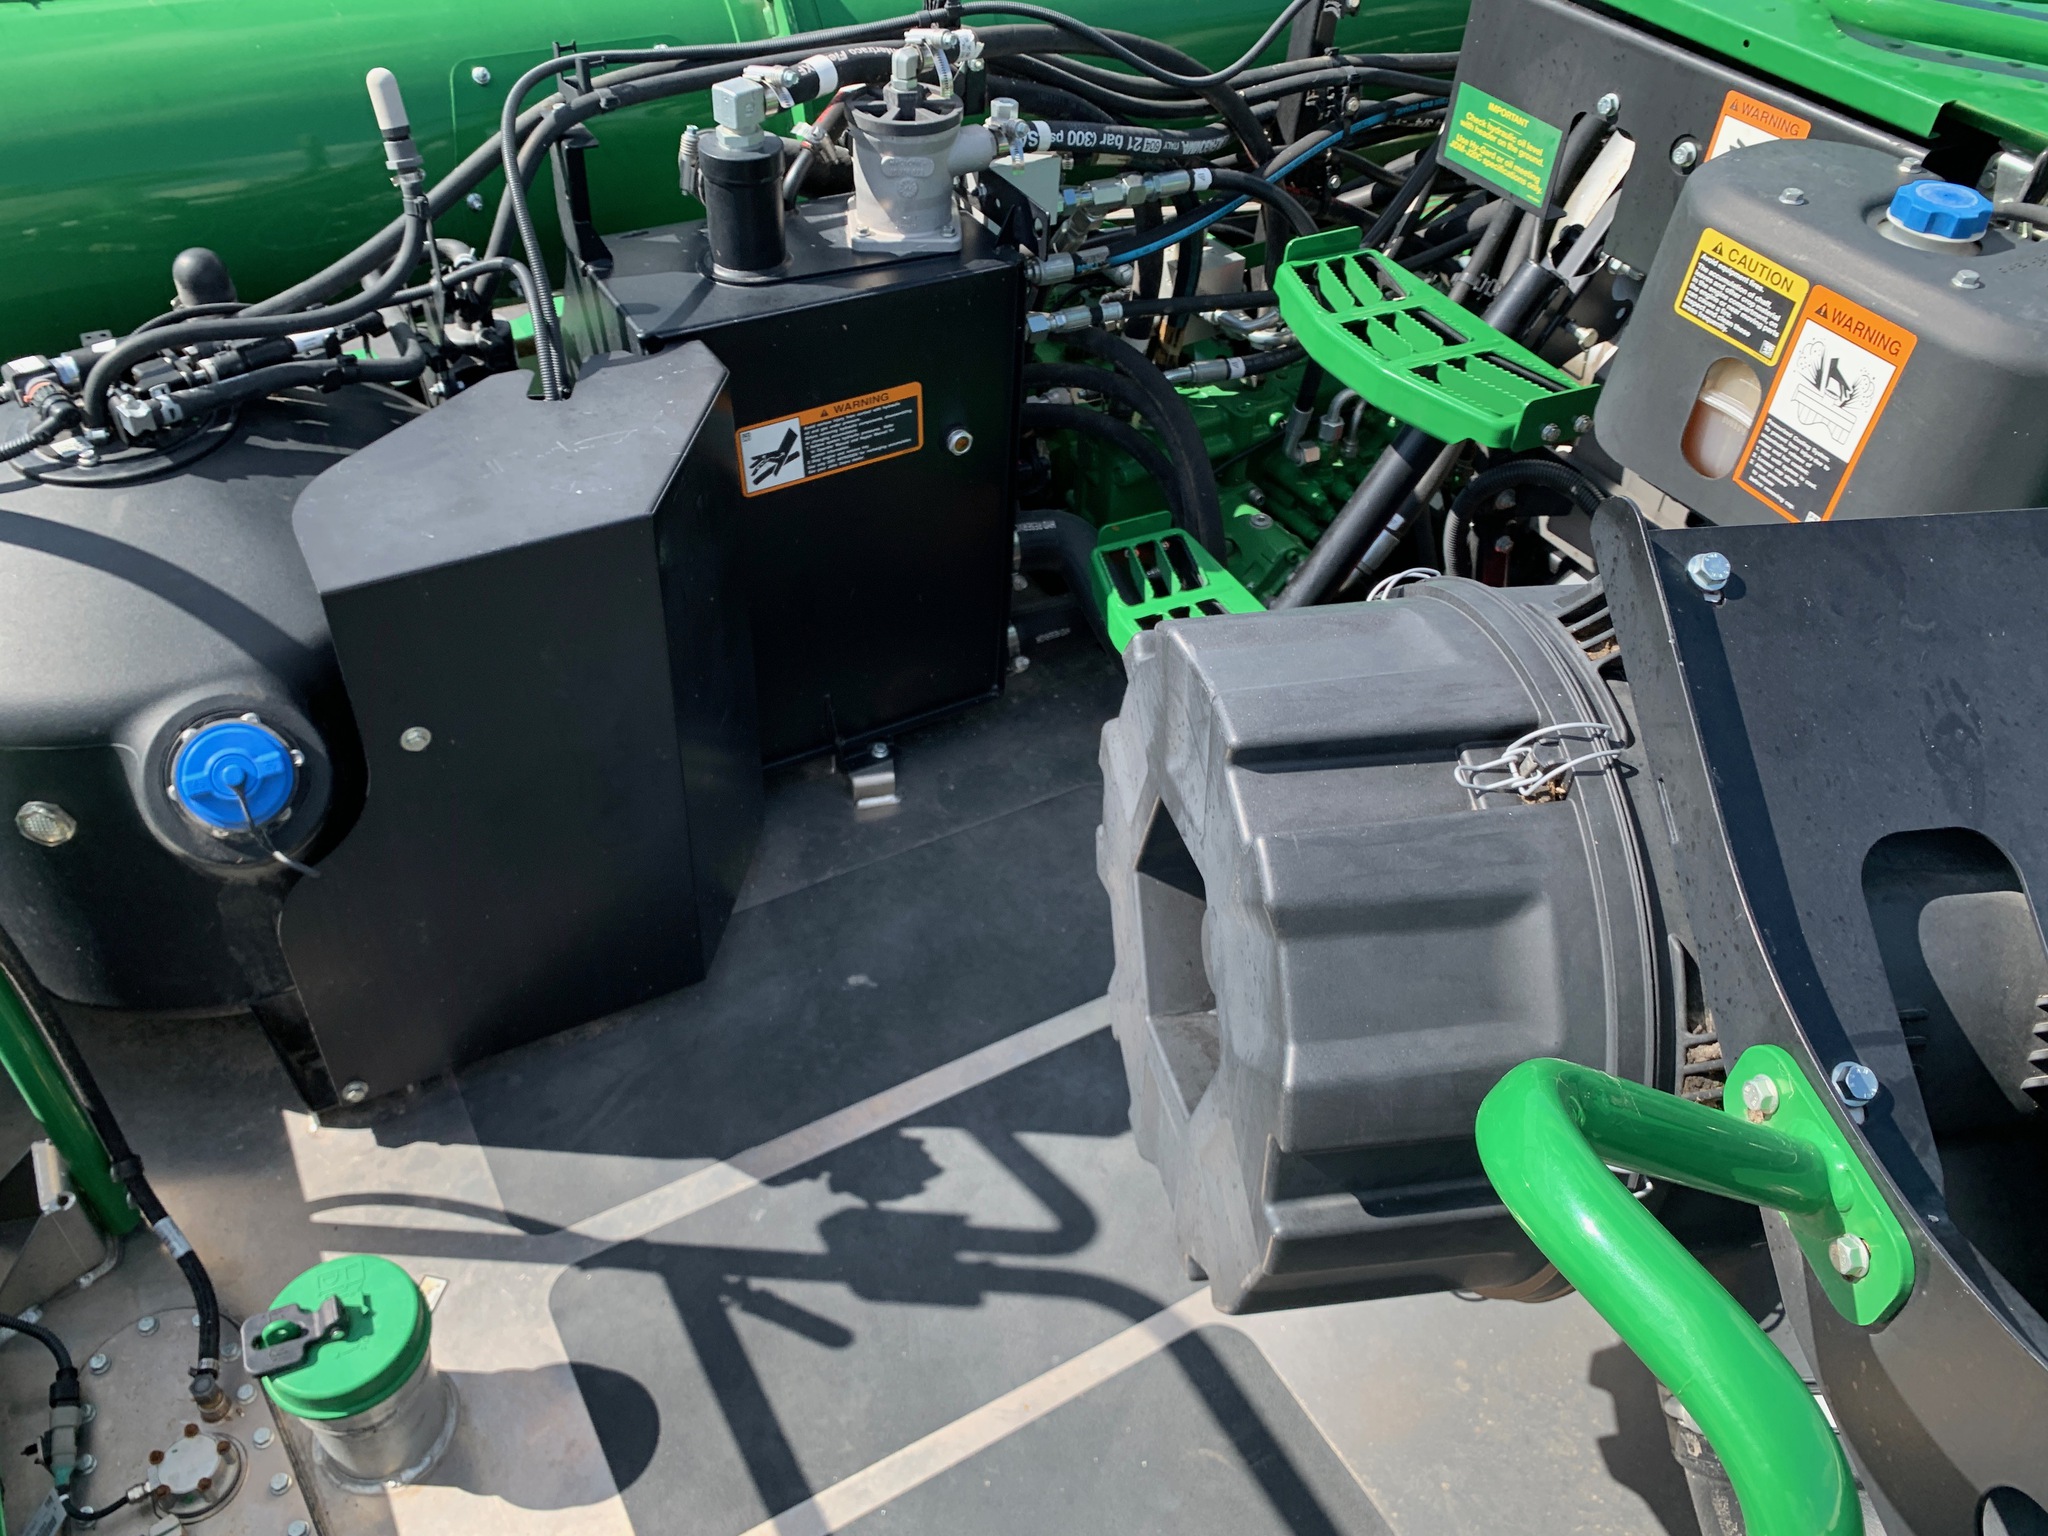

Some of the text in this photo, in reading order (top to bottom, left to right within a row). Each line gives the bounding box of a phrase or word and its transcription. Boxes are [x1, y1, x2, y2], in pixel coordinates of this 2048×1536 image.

[1488, 102, 1529, 127] IMPORTANT
[1742, 102, 1800, 136] WARNING
[1067, 129, 1097, 148] (300
[1100, 133, 1124, 150] bar
[1127, 136, 1142, 152] 21
[1728, 248, 1794, 292] CAUTION
[1831, 307, 1902, 357] WARNING
[833, 393, 889, 413] WARNING
